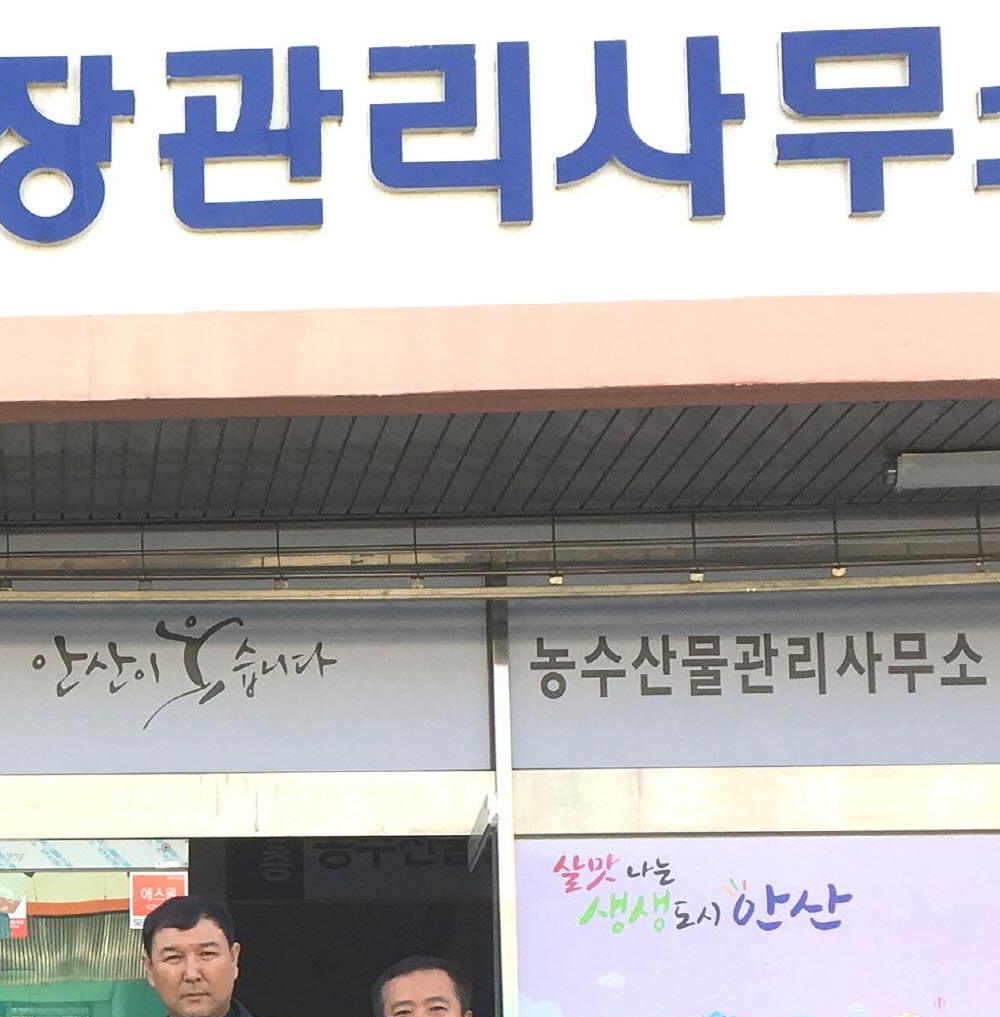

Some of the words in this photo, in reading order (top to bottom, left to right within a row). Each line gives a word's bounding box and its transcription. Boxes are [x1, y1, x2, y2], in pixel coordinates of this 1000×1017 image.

[32, 635, 160, 698] 안산이
[530, 631, 988, 699] 농수산물관리사무소
[553, 853, 620, 893] 살맛
[627, 858, 675, 886] 나는
[733, 883, 853, 931] 안산
